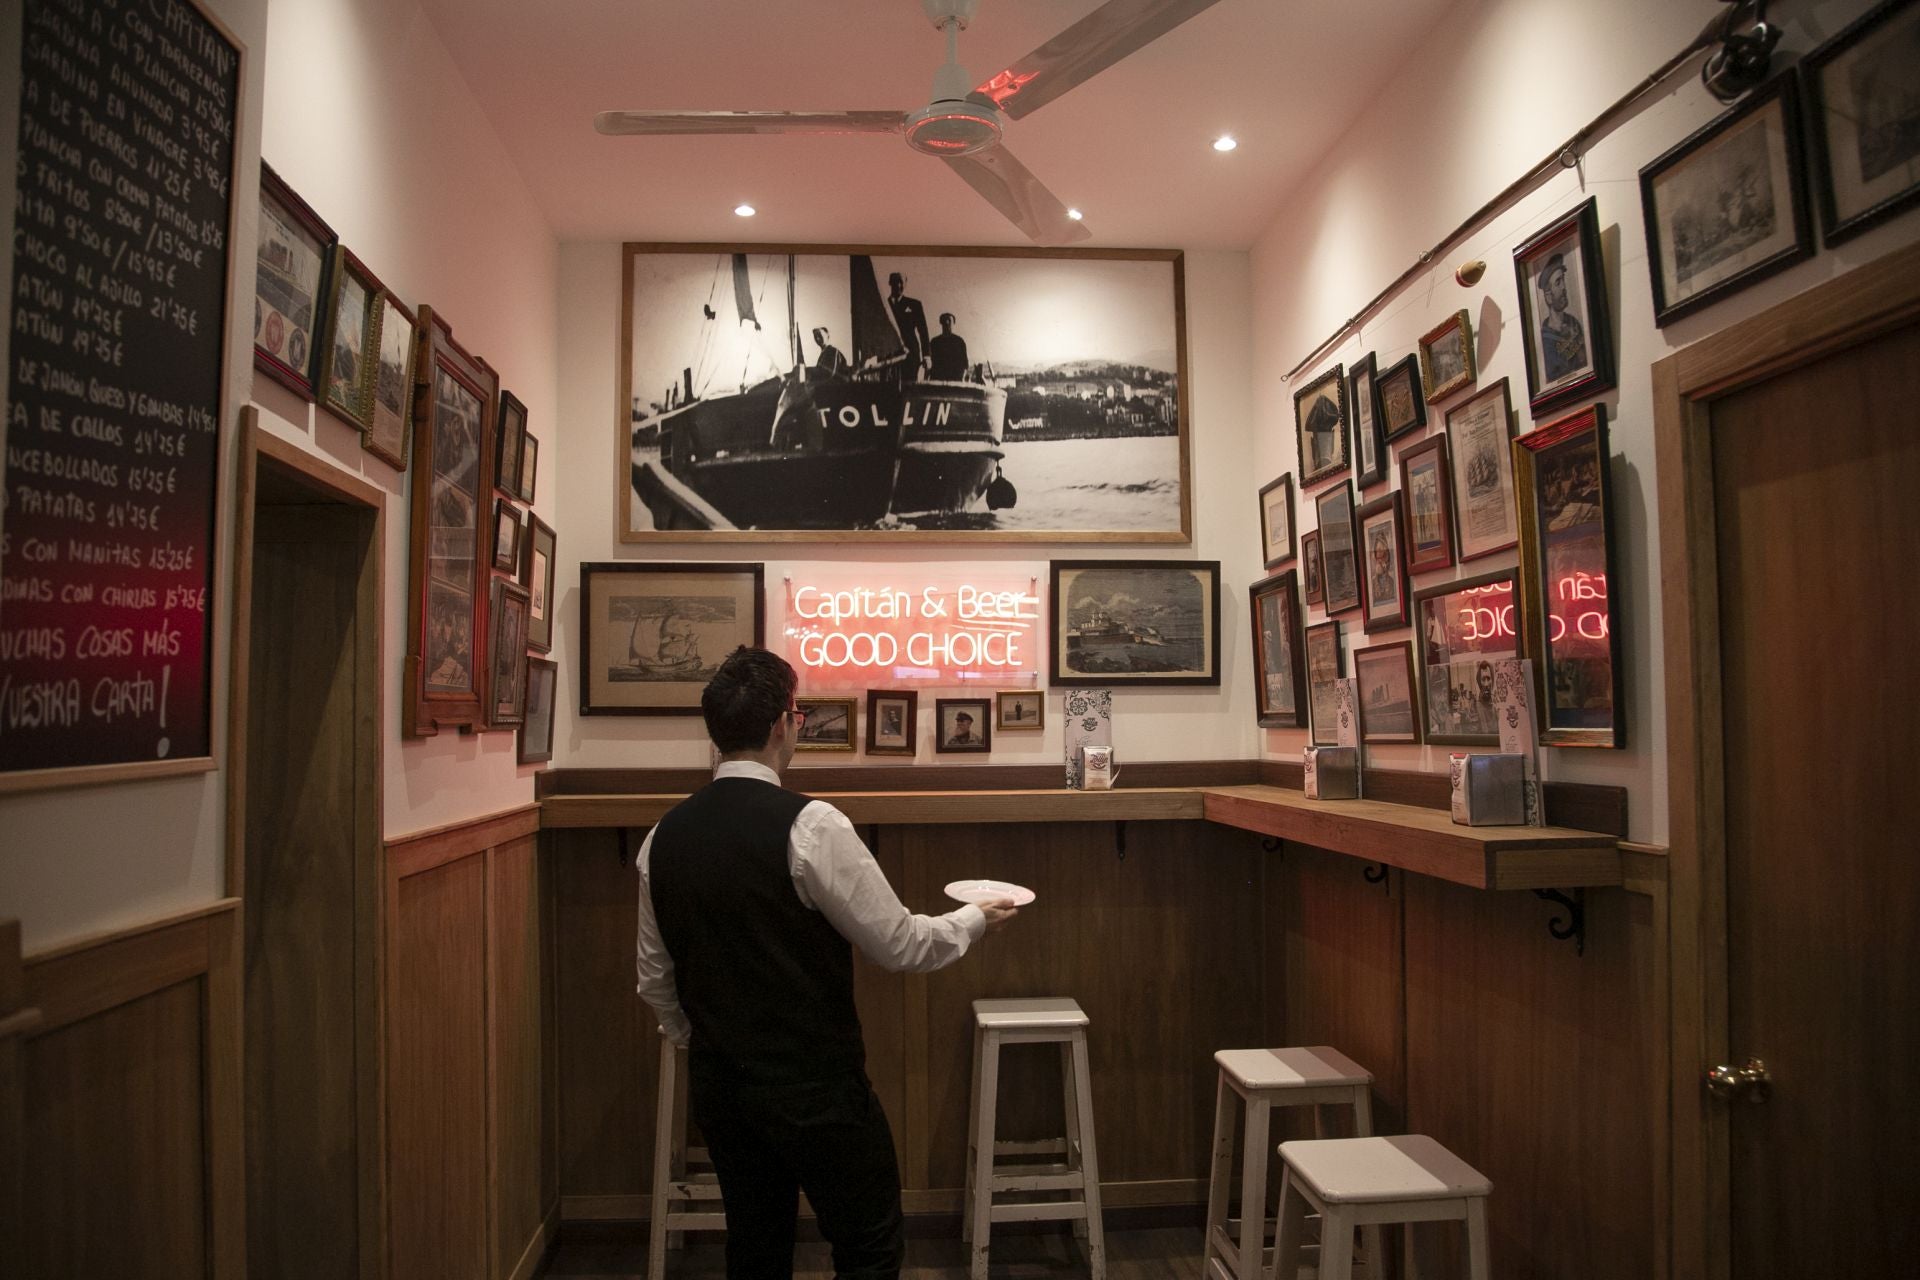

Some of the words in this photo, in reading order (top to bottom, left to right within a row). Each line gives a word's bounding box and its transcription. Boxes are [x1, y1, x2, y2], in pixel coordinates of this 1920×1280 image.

[28, 33, 98, 100] SARDINA
[106, 93, 125, 120] EN
[91, 9, 102, 37] A
[109, 25, 128, 55] LA
[134, 43, 191, 106] PLANCHA
[23, 114, 82, 170] PLANCHA
[88, 158, 113, 187] CON
[50, 91, 70, 125] DE
[79, 107, 138, 169] PUERROS
[15, 228, 67, 275] CHOCO
[75, 263, 94, 289] AL
[18, 355, 37, 386] DE
[40, 404, 62, 433] DE
[71, 415, 124, 447] CALLOS
[17, 486, 96, 523] PATATAS
[22, 538, 58, 562] CON
[61, 583, 94, 604] CON
[920, 586, 947, 618] &
[957, 584, 1028, 619] Beer
[75, 624, 135, 659] COSAS
[143, 617, 182, 657] MÁS
[799, 632, 898, 667] GOOD
[907, 631, 1023, 667] CHOICE
